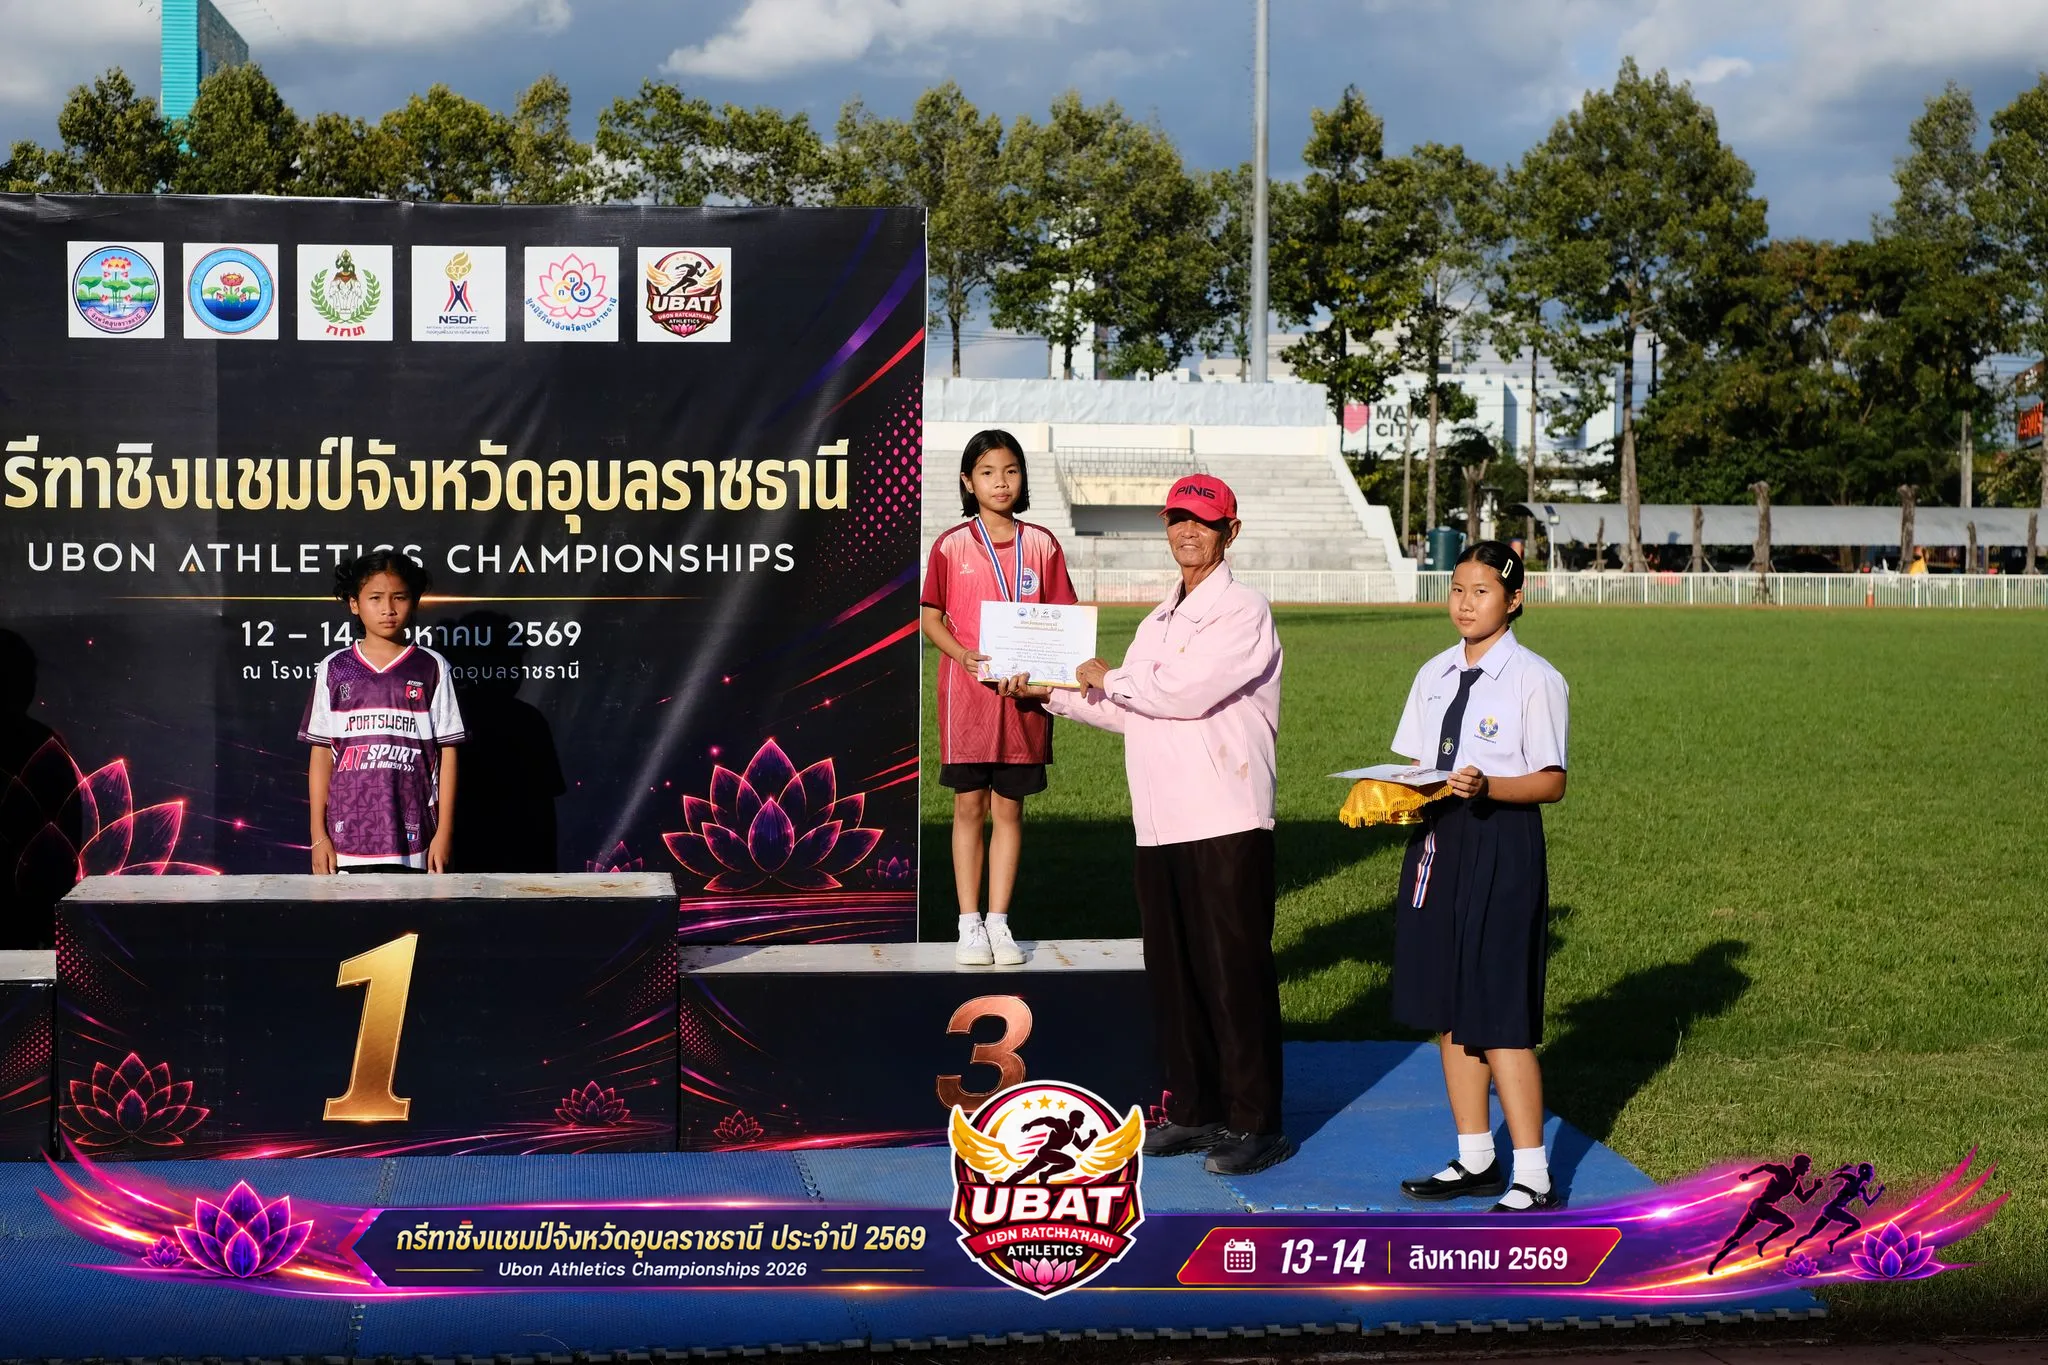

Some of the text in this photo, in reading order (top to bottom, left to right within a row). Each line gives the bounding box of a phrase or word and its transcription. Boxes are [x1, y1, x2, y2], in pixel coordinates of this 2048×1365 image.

[652, 295, 717, 312] UBAT
[438, 315, 477, 324] NSDF
[1174, 484, 1217, 499] PING
[28, 542, 795, 574] UBON ATHLETIS CHAMPIONSHIPS
[241, 621, 275, 647] 12
[320, 621, 354, 647] 14
[507, 621, 582, 647] 2569
[242, 665, 261, 679] ณ
[323, 933, 419, 1123] 1
[936, 994, 1033, 1114] 3
